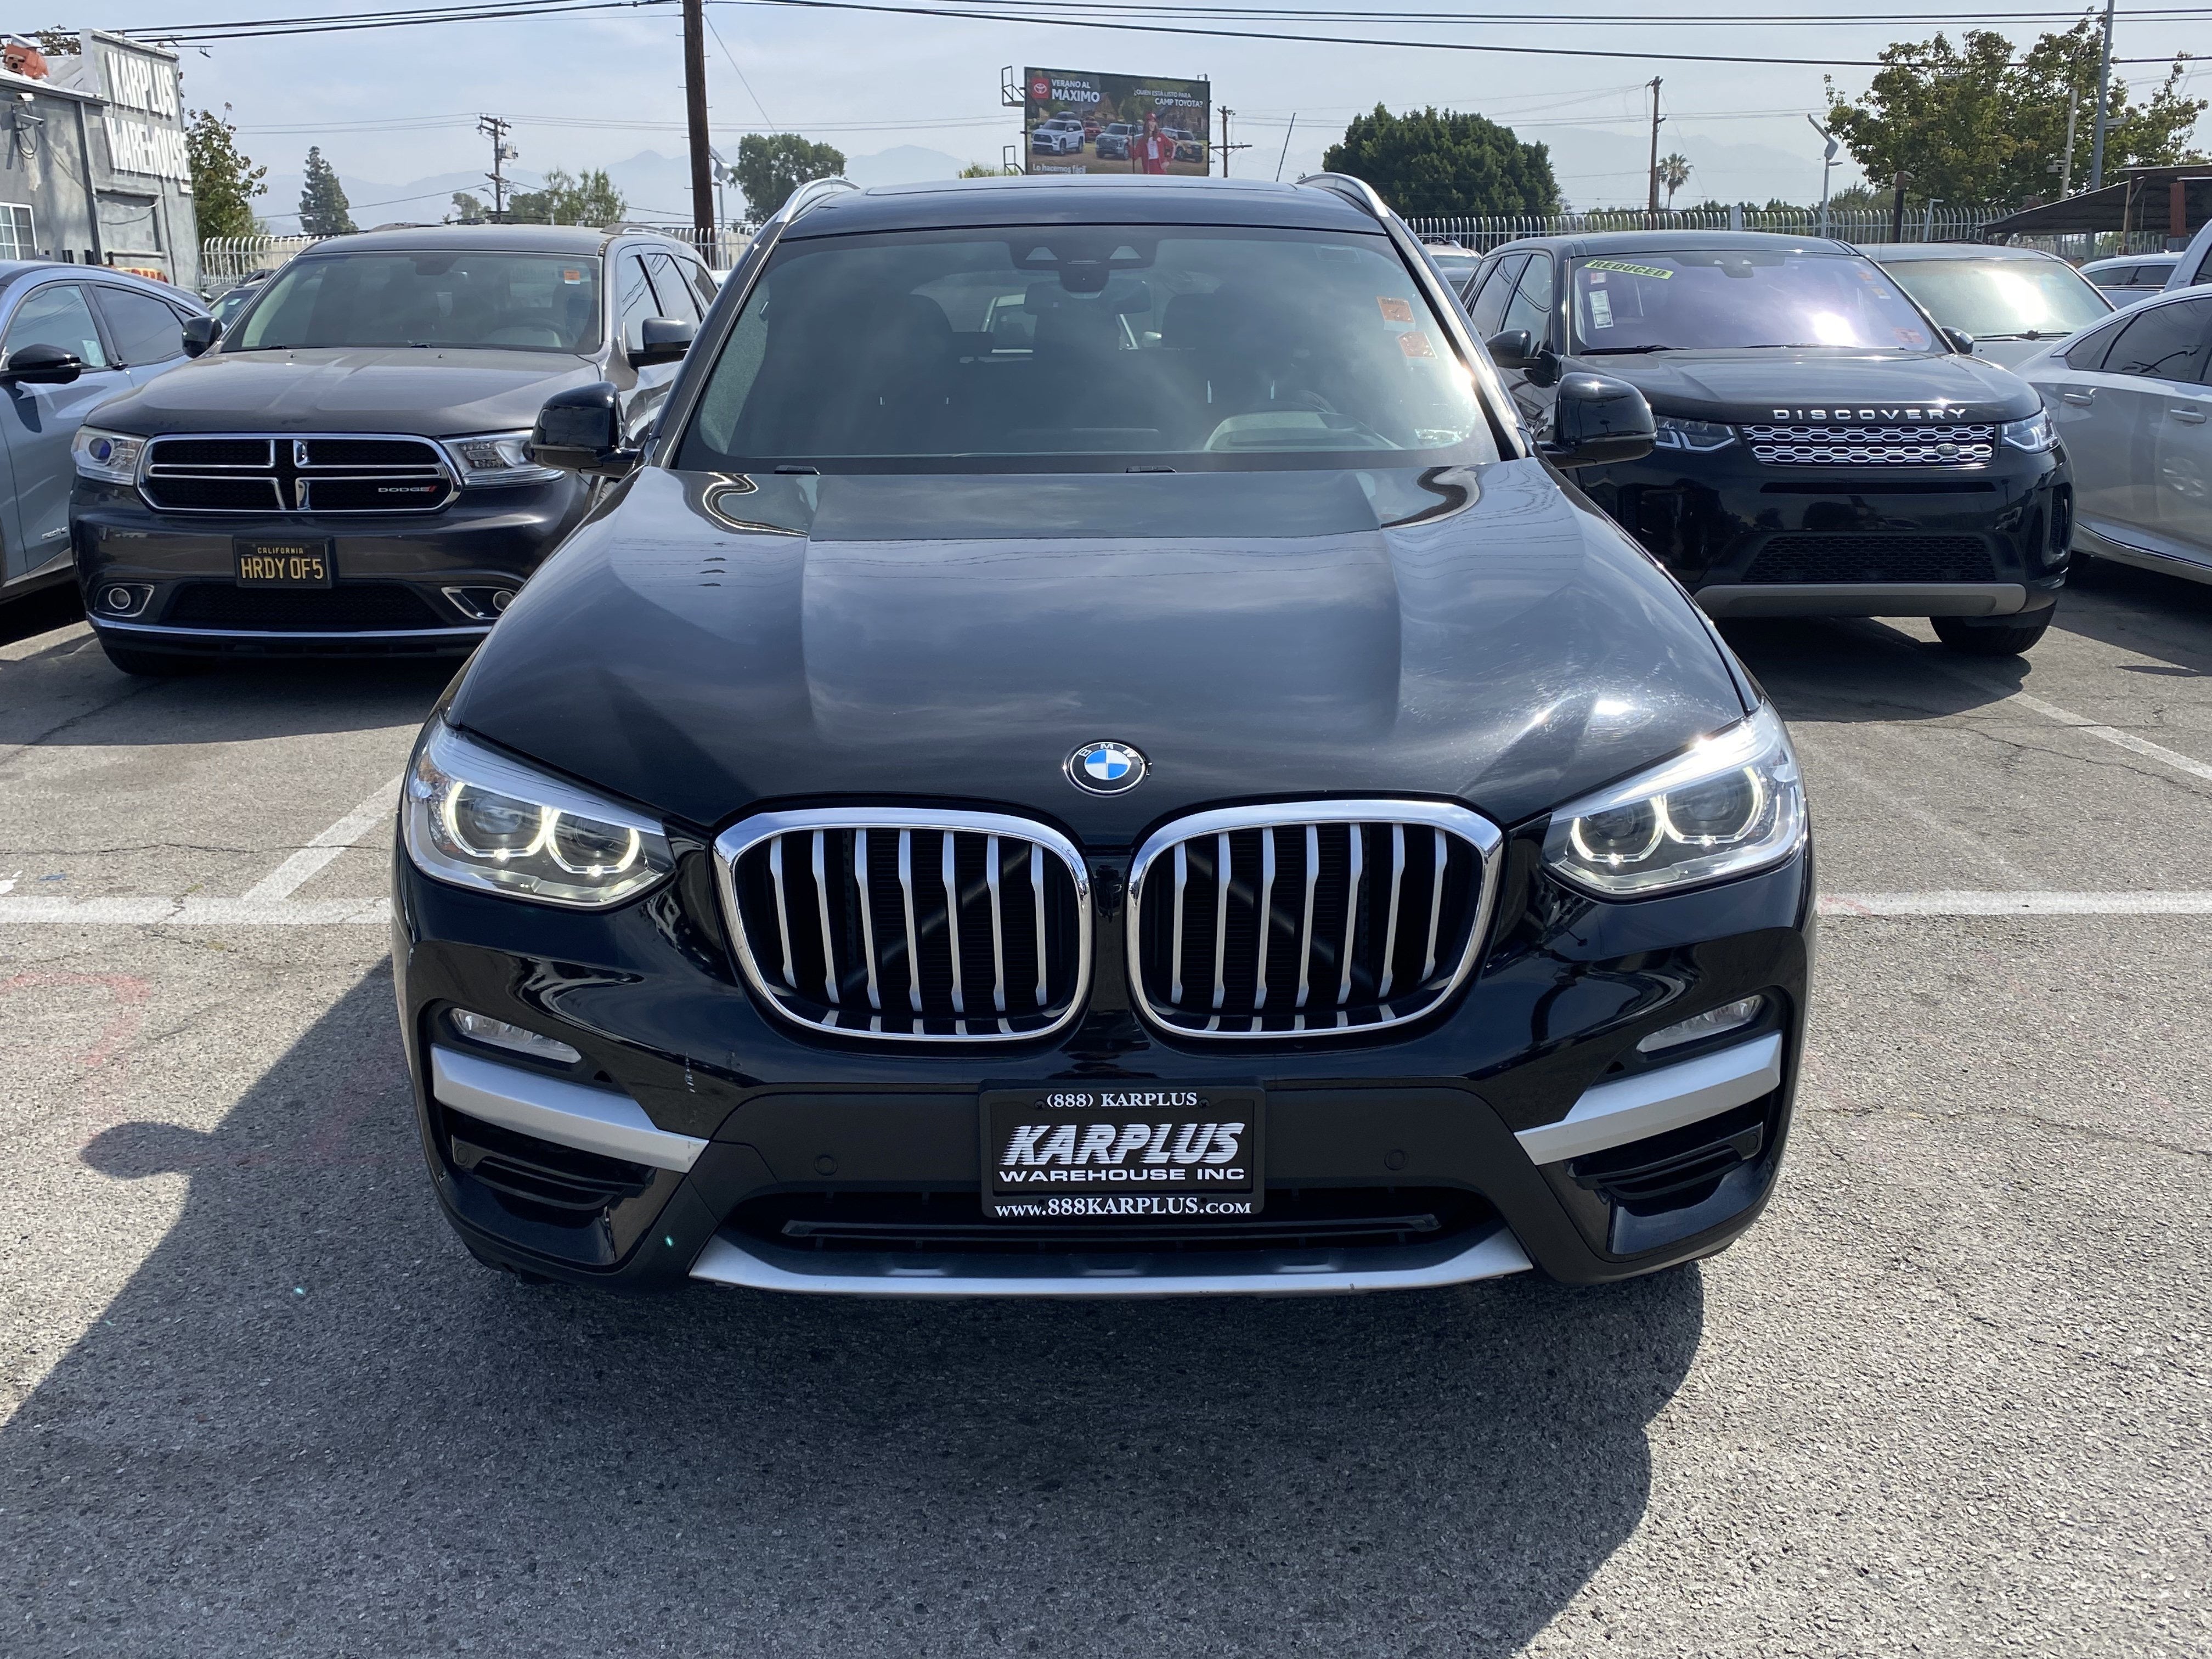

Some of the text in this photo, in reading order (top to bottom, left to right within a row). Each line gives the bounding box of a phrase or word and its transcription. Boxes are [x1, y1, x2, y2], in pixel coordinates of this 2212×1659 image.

[107, 52, 177, 117] KARPLUS
[1051, 79, 1081, 88] VERANO
[1052, 87, 1100, 103] MÁXIMO
[1175, 99, 1203, 108] TOYOTA?
[104, 116, 192, 180] WAREHOUSE
[1042, 164, 1071, 173] hacemos
[1590, 261, 1668, 276] REDUCED
[1774, 408, 1966, 420] DISCOVERY
[241, 557, 285, 579] HRDY
[1079, 743, 1138, 758] BMW
[1046, 1092, 1197, 1107] (888) KARPLUS
[998, 1122, 1245, 1166] KARPLUS
[999, 1168, 1245, 1182] WAREHOUSE INC
